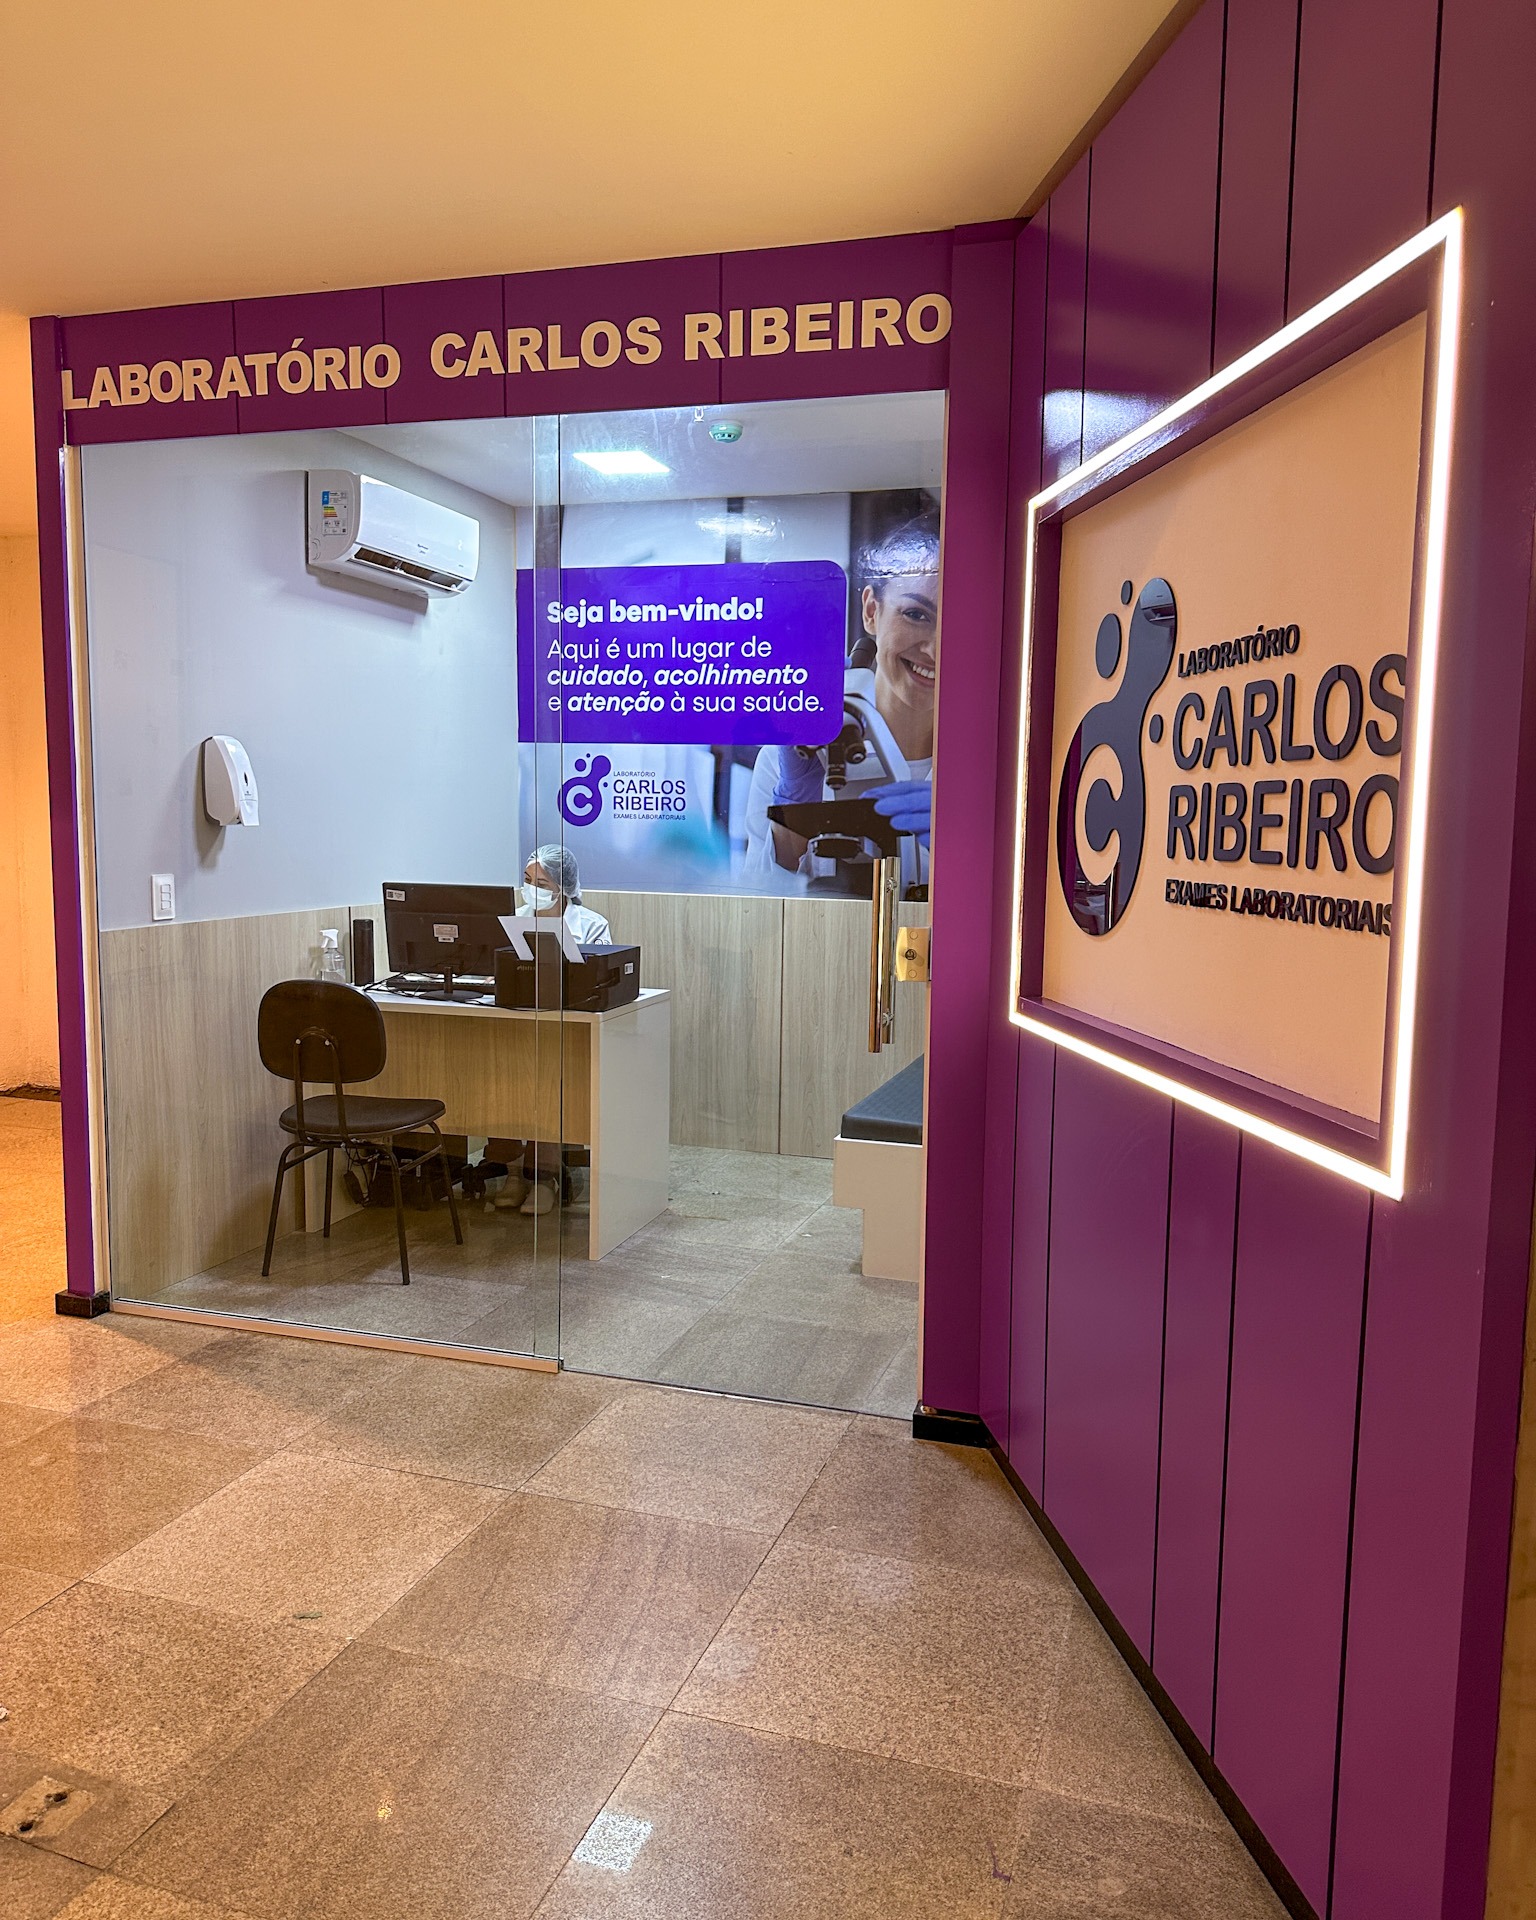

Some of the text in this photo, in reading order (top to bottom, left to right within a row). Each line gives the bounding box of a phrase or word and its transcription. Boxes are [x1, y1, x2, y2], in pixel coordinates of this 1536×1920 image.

[61, 293, 952, 410] LABORATÓRIO CARLOS RIBEIRO
[547, 596, 764, 628] Seja bem-vindo!
[547, 635, 772, 663] Aqui é um lugar de
[1178, 624, 1300, 678] LABORATÓRIO
[547, 663, 808, 688] cuidado, acolhimento
[548, 690, 825, 716] e atenção à sua saúde.
[1173, 653, 1408, 770] CARLOS
[613, 770, 656, 778] LABORATÓRIO
[613, 779, 686, 795] CARLOS
[613, 796, 686, 812] RIBEIRO
[1166, 774, 1401, 875] RIBEIRO
[1165, 878, 1229, 911] EXAMES
